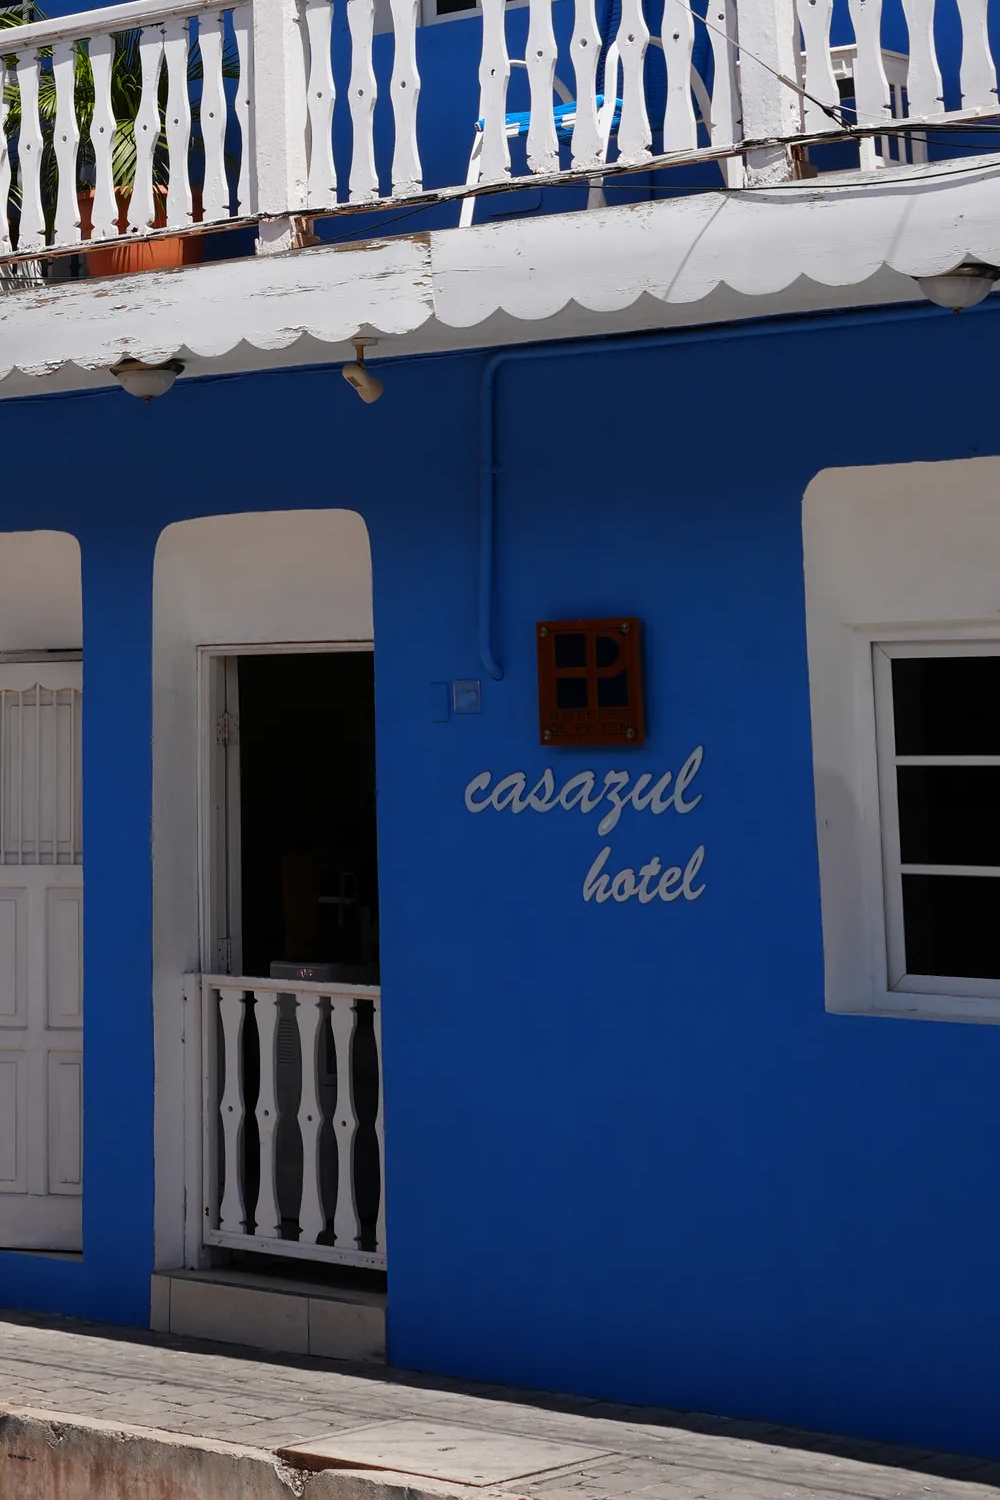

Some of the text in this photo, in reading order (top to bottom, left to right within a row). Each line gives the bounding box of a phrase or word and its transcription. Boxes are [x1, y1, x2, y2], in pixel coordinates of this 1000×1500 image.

[548, 708, 630, 721] HOTELES
[550, 722, 569, 733] DE
[464, 744, 704, 837] casazul
[582, 844, 706, 904] hotel
